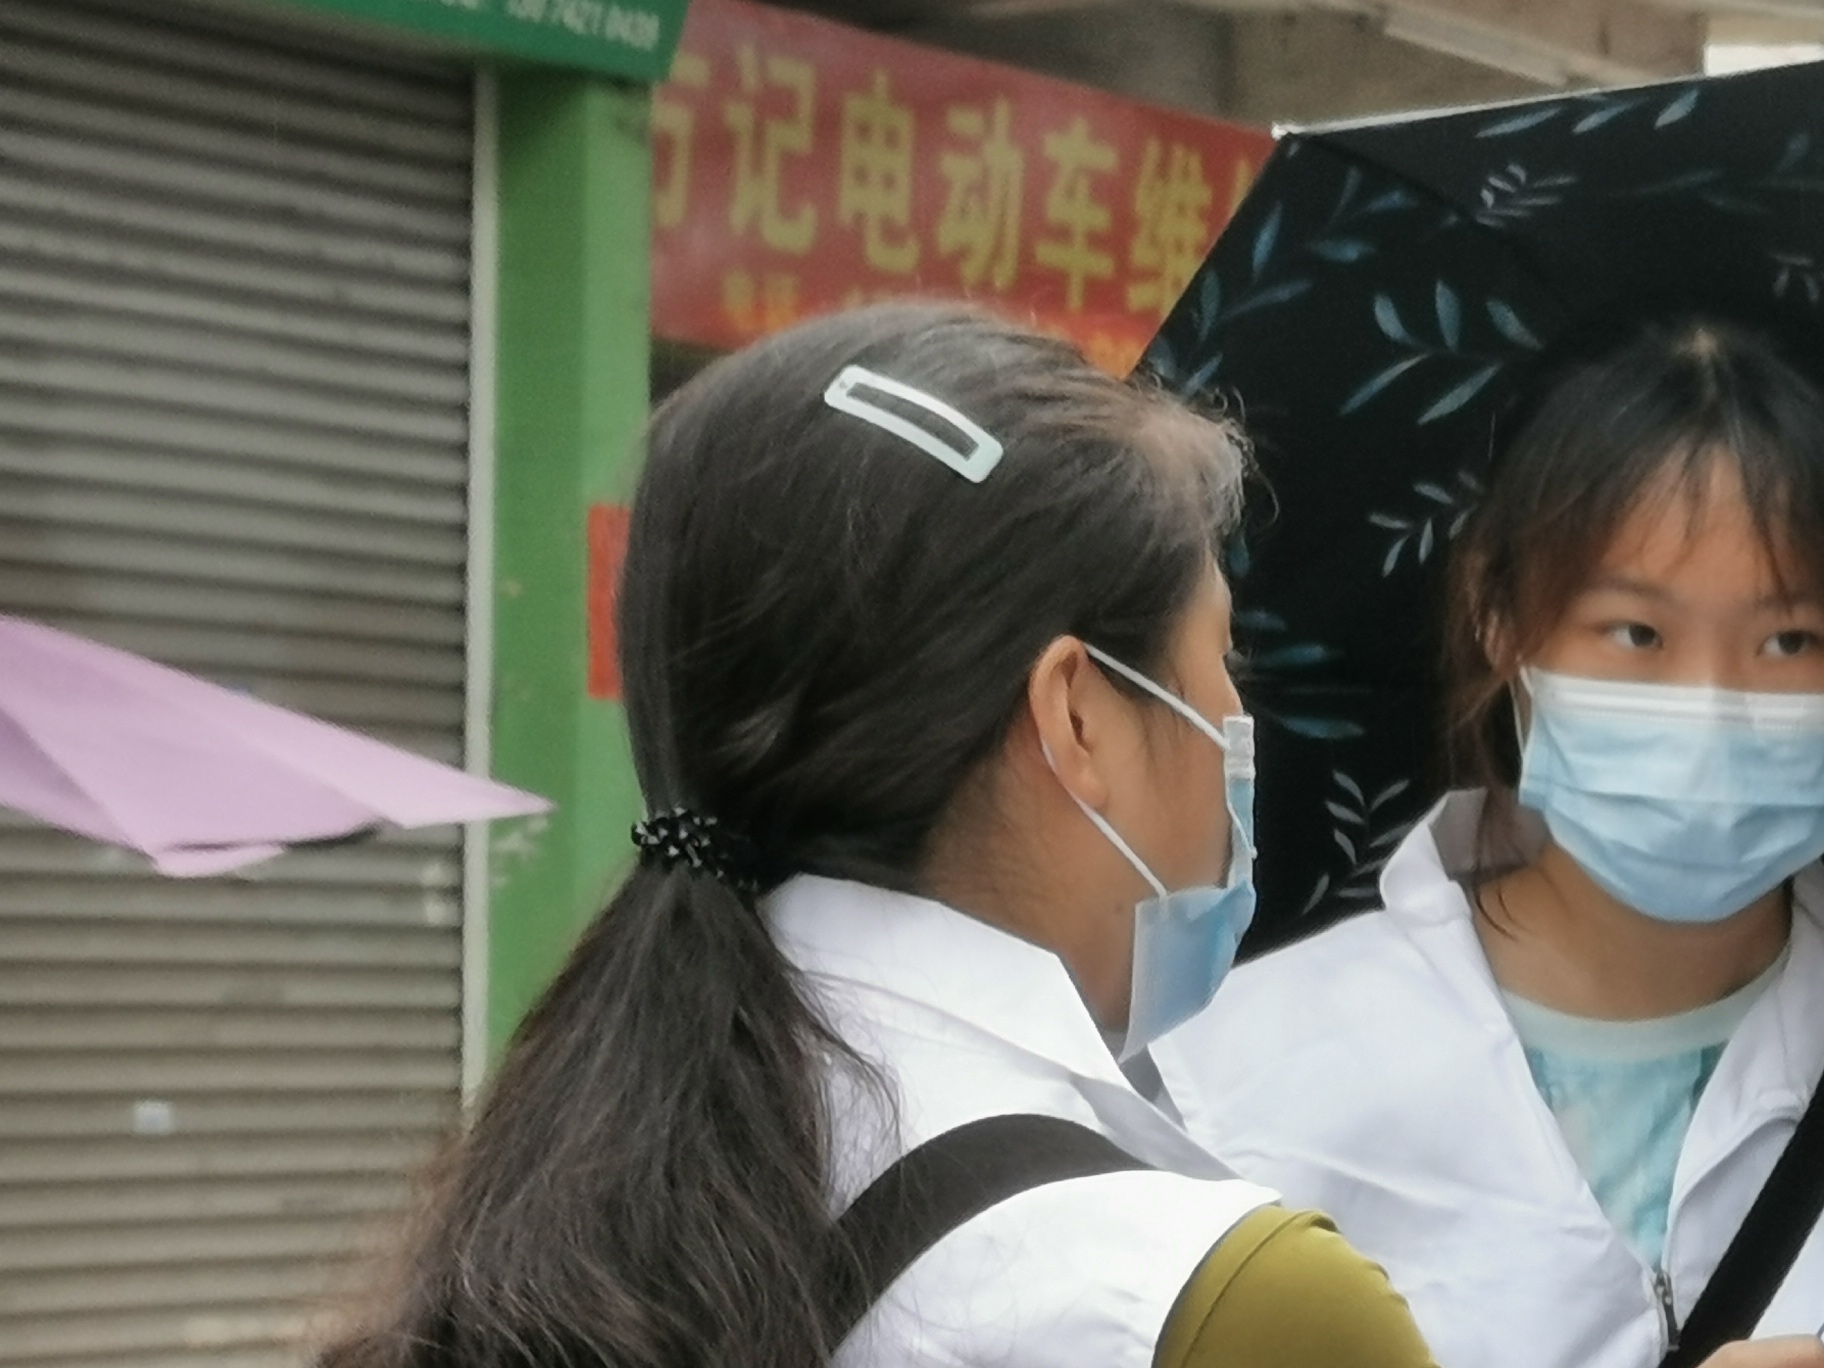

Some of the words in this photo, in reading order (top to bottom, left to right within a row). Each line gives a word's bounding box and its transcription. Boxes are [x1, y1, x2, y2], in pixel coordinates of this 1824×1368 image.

[652, 40, 1252, 316] 记电动车维
